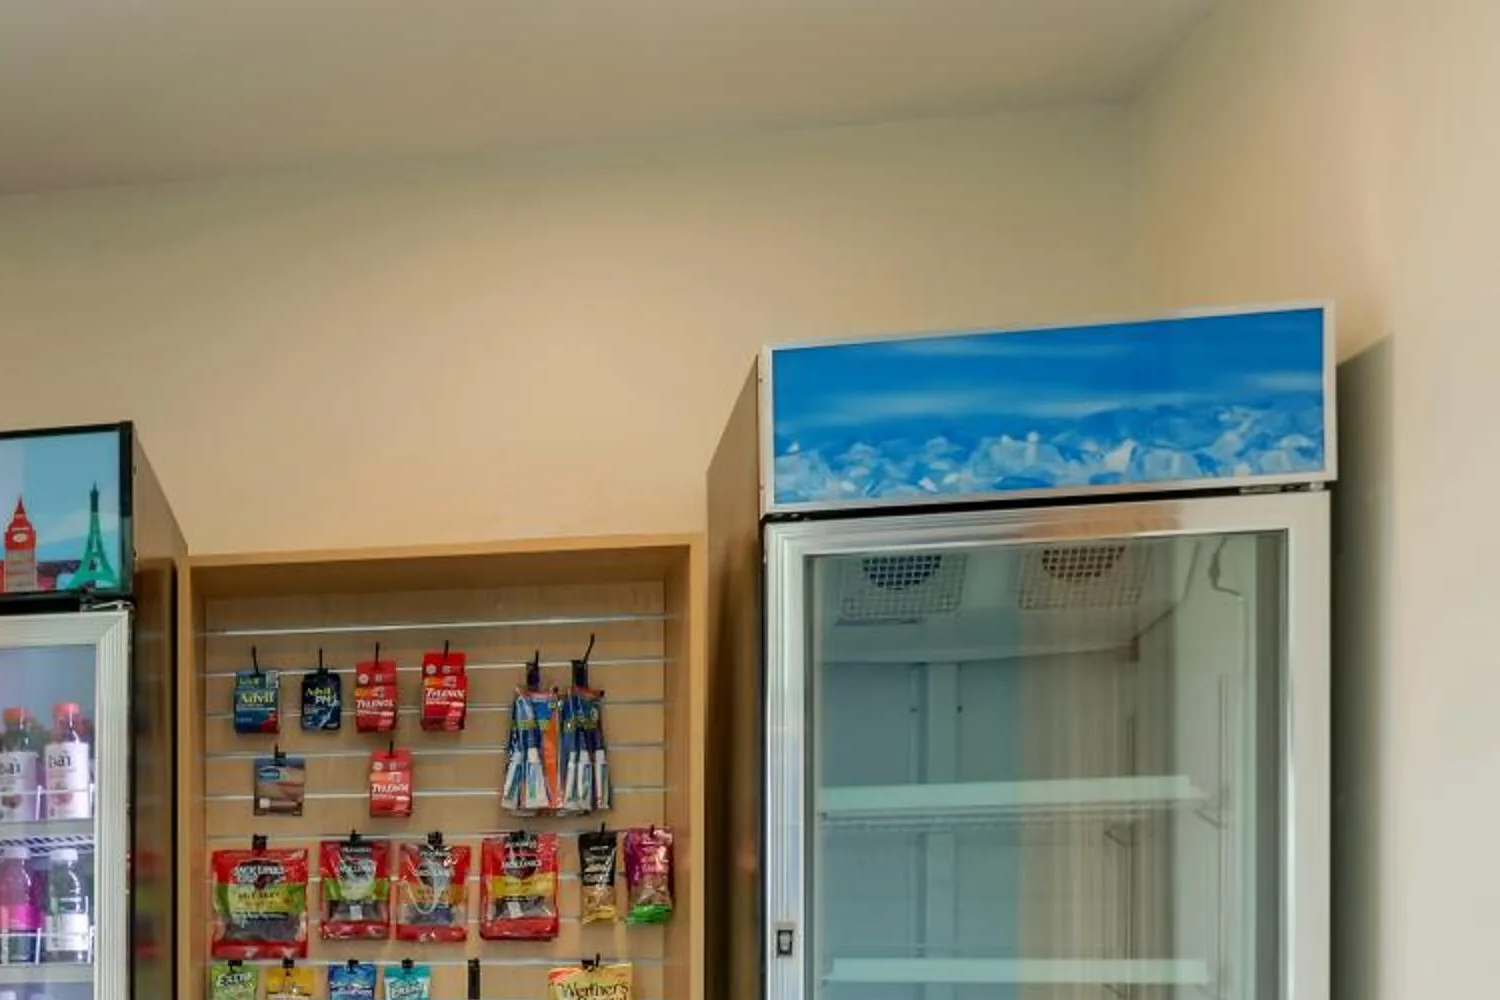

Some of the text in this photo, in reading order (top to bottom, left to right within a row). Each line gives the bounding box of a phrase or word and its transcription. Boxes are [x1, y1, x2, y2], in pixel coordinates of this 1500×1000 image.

[241, 690, 275, 704] Advil
[304, 686, 333, 696] Advil
[560, 980, 629, 998] Werther's
